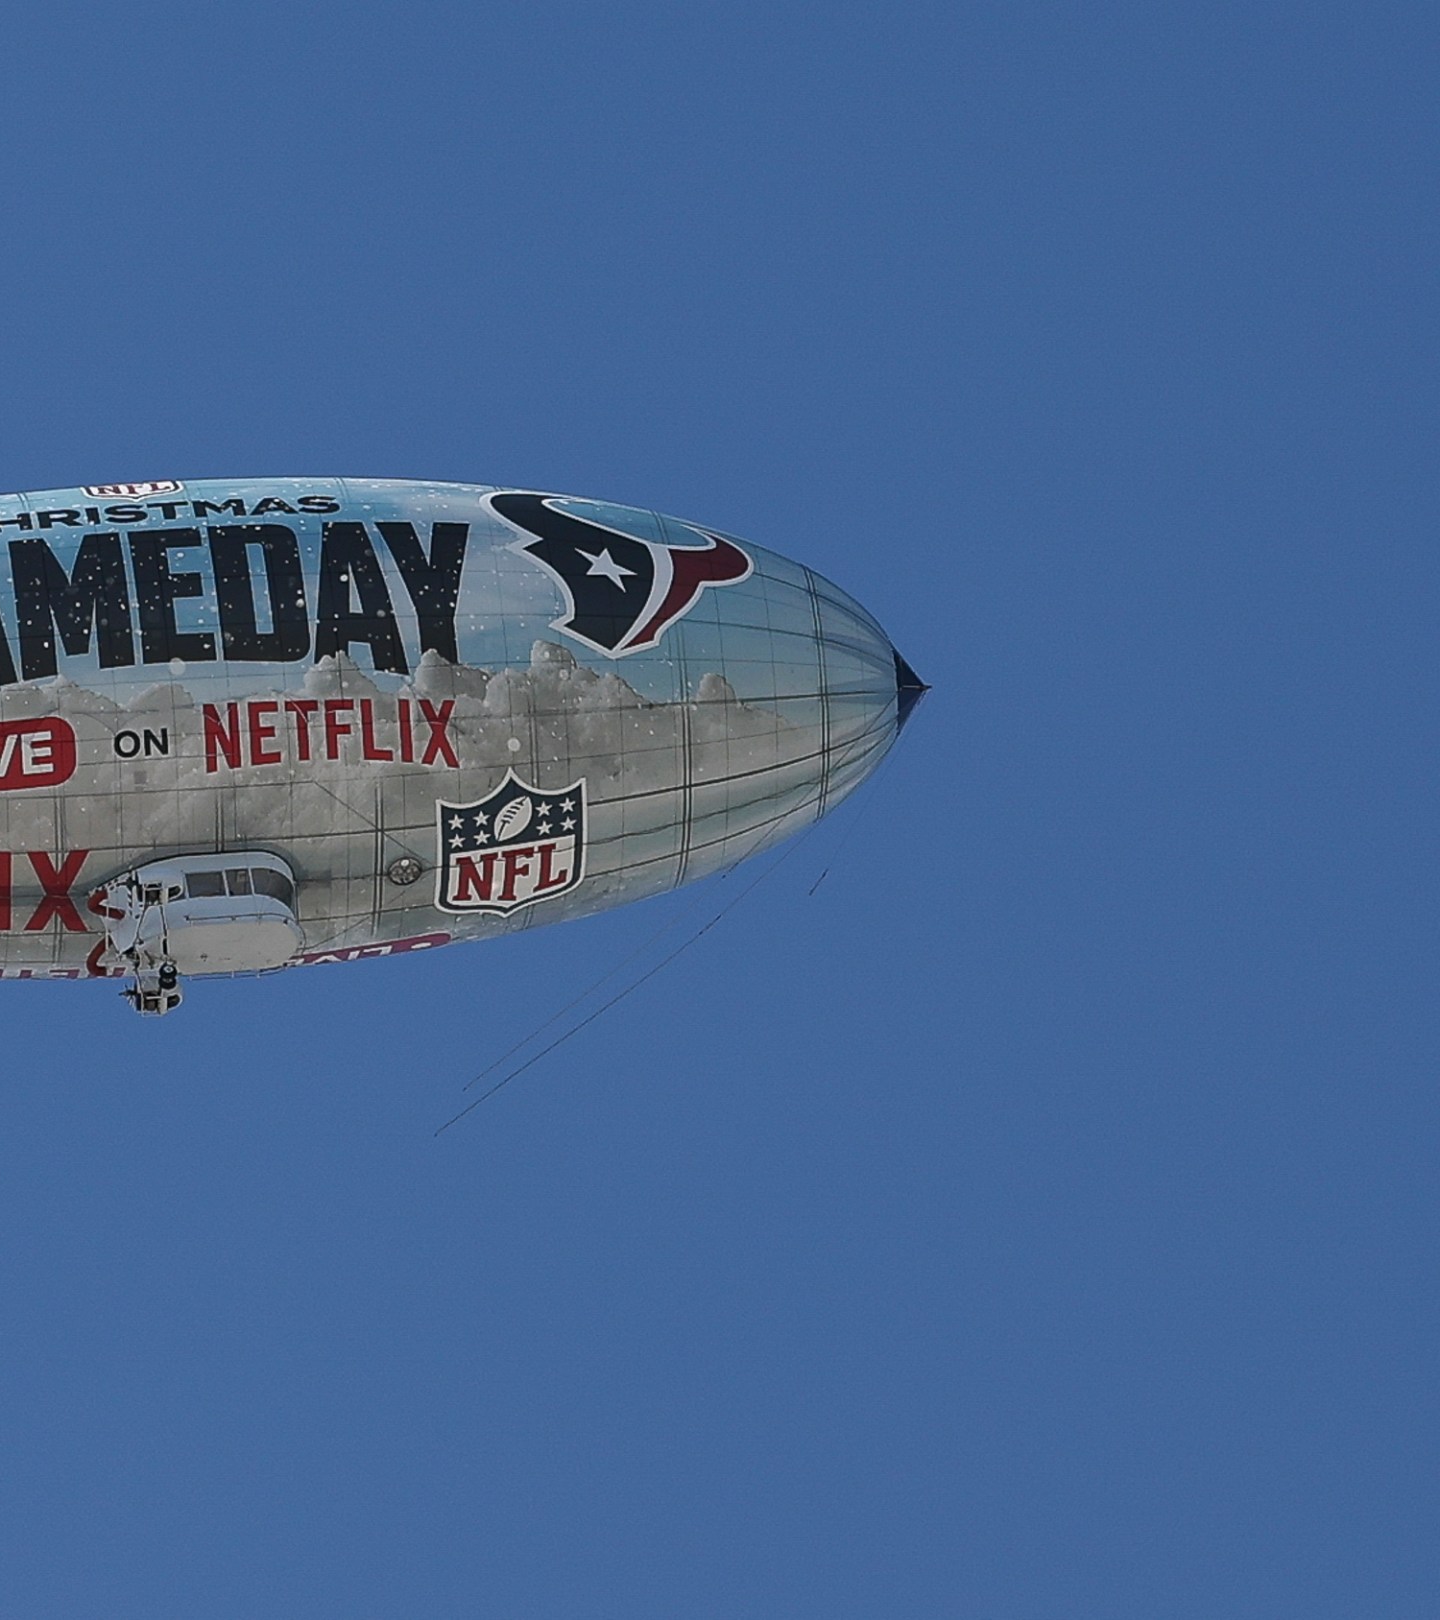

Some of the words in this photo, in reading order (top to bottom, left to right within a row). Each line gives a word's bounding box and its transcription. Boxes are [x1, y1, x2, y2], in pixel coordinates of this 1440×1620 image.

[114, 728, 169, 759] ON
[202, 699, 460, 773] NETFLIX
[452, 843, 568, 901] NFL
